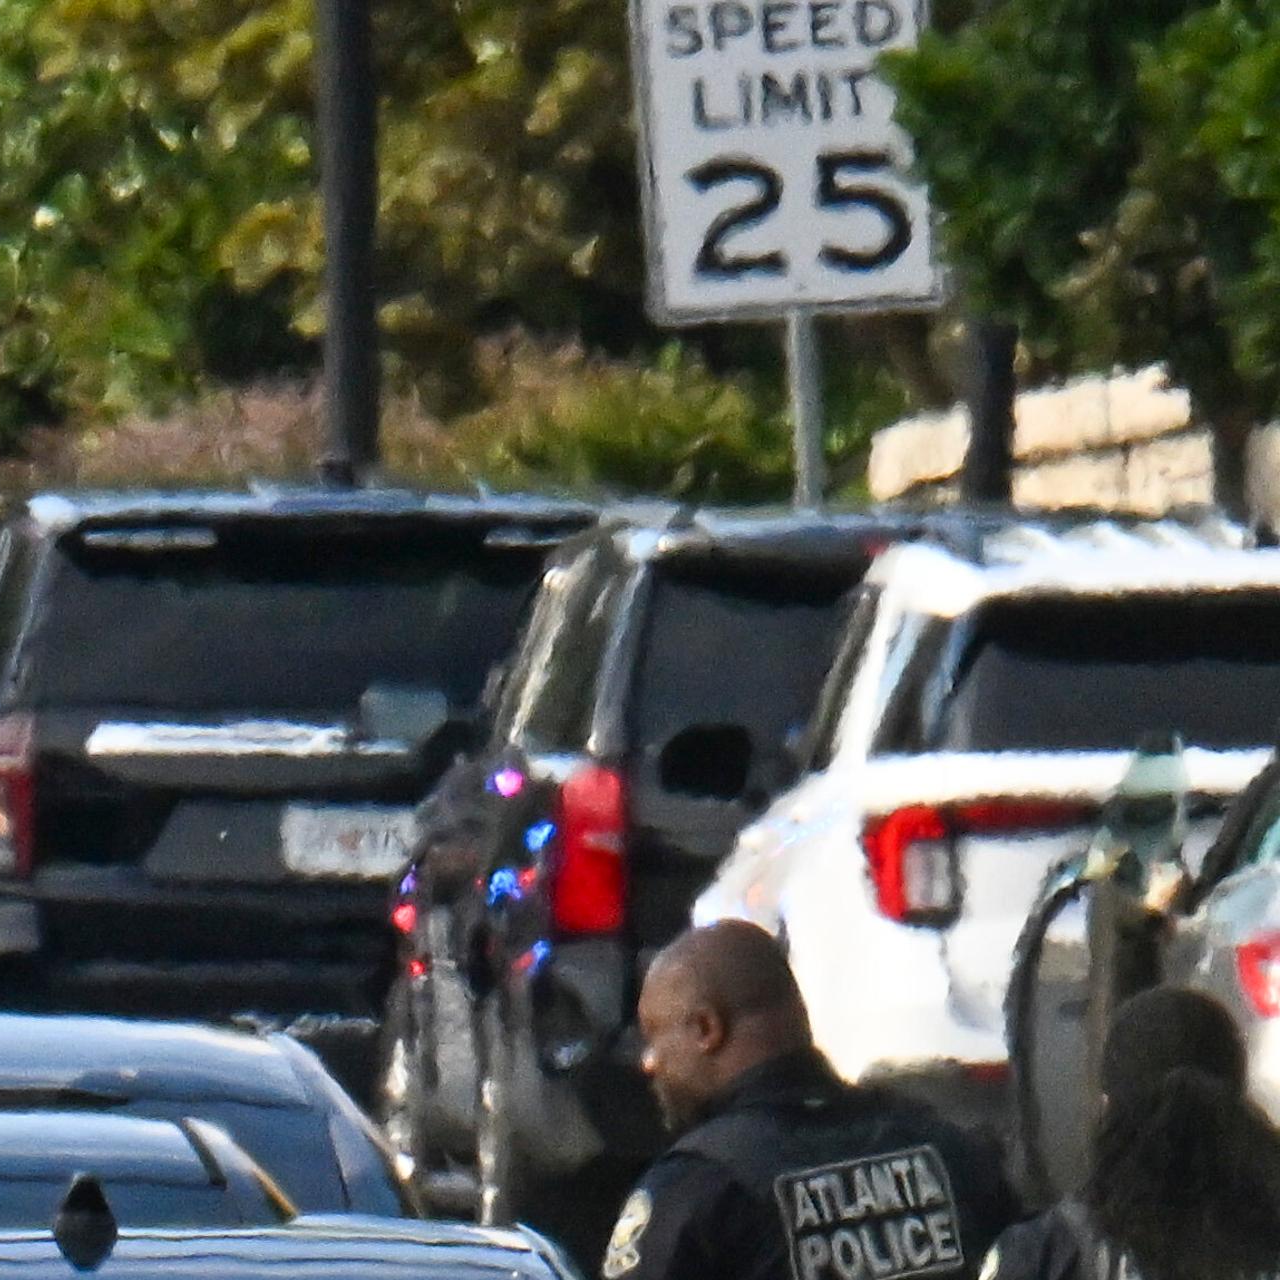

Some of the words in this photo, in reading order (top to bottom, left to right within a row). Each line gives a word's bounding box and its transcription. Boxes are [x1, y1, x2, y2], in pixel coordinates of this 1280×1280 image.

[666, 0, 900, 57] SPEED
[694, 66, 874, 129] LIMIT
[684, 148, 913, 279] 25
[793, 1155, 946, 1228] ATLANTA
